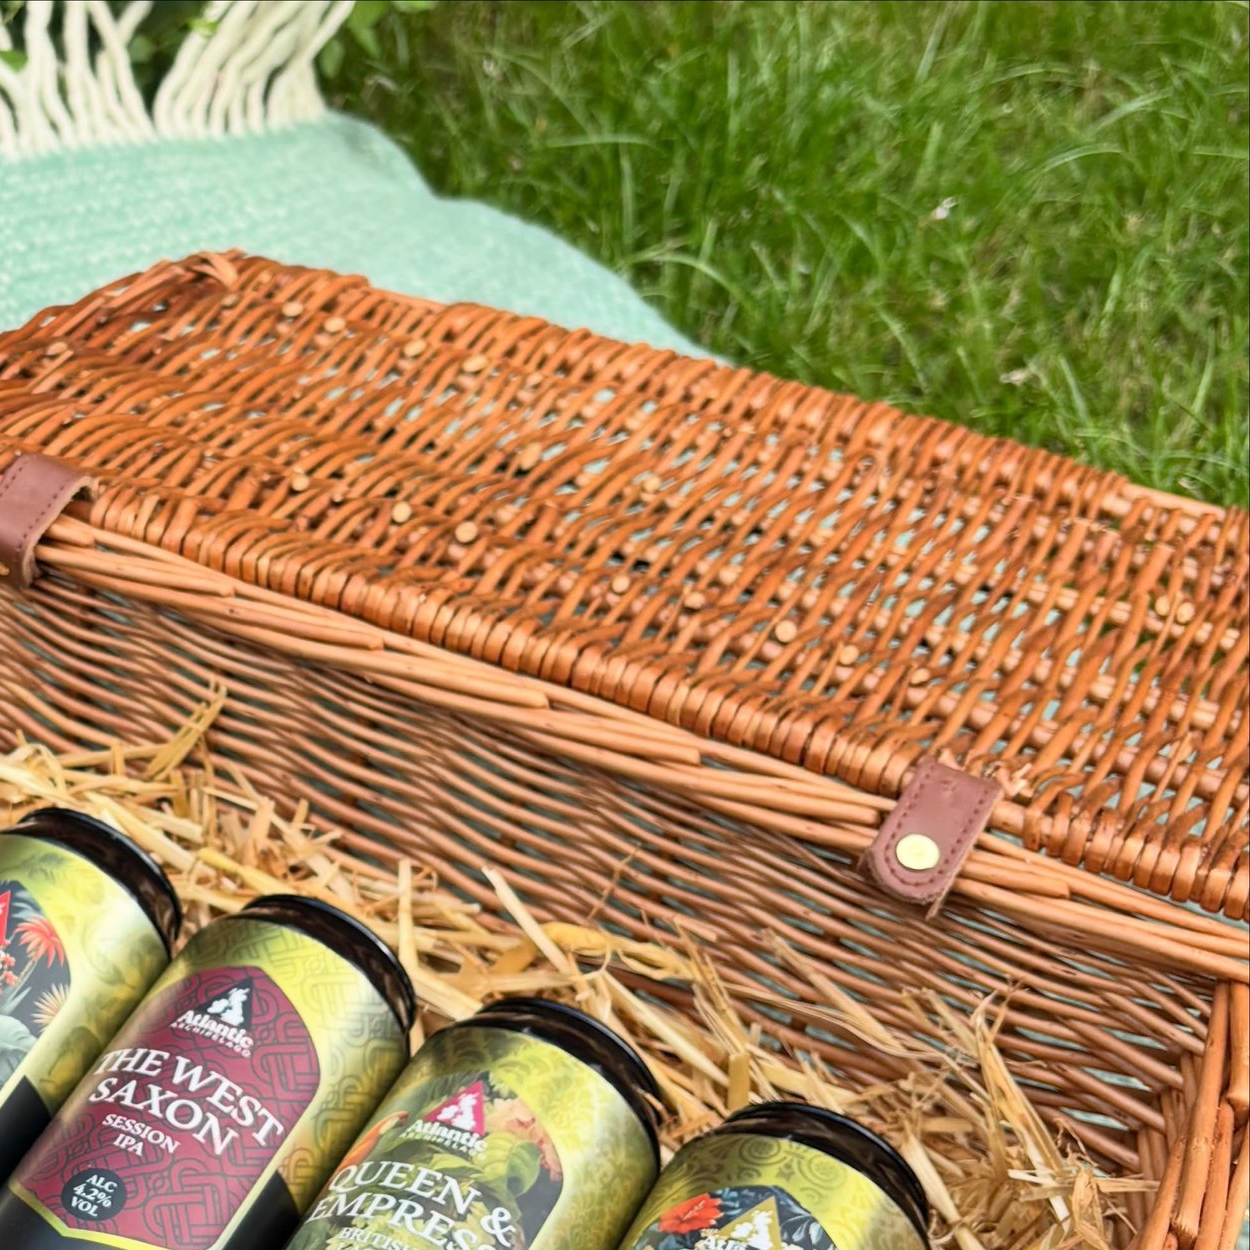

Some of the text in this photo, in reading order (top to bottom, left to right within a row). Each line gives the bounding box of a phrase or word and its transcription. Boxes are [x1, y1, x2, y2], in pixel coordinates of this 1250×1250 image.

[177, 1010, 254, 1049] Atlantic
[94, 1047, 284, 1147] THE WEST
[89, 1077, 240, 1156] SAXON
[102, 1113, 180, 1154] SESSION
[113, 1133, 143, 1156] IPA
[405, 1119, 488, 1151] Atlantic
[73, 1182, 113, 1209] 4.2%
[85, 1173, 118, 1194] ALC
[69, 1196, 100, 1218] VOL
[328, 1160, 517, 1248] QUEEN &
